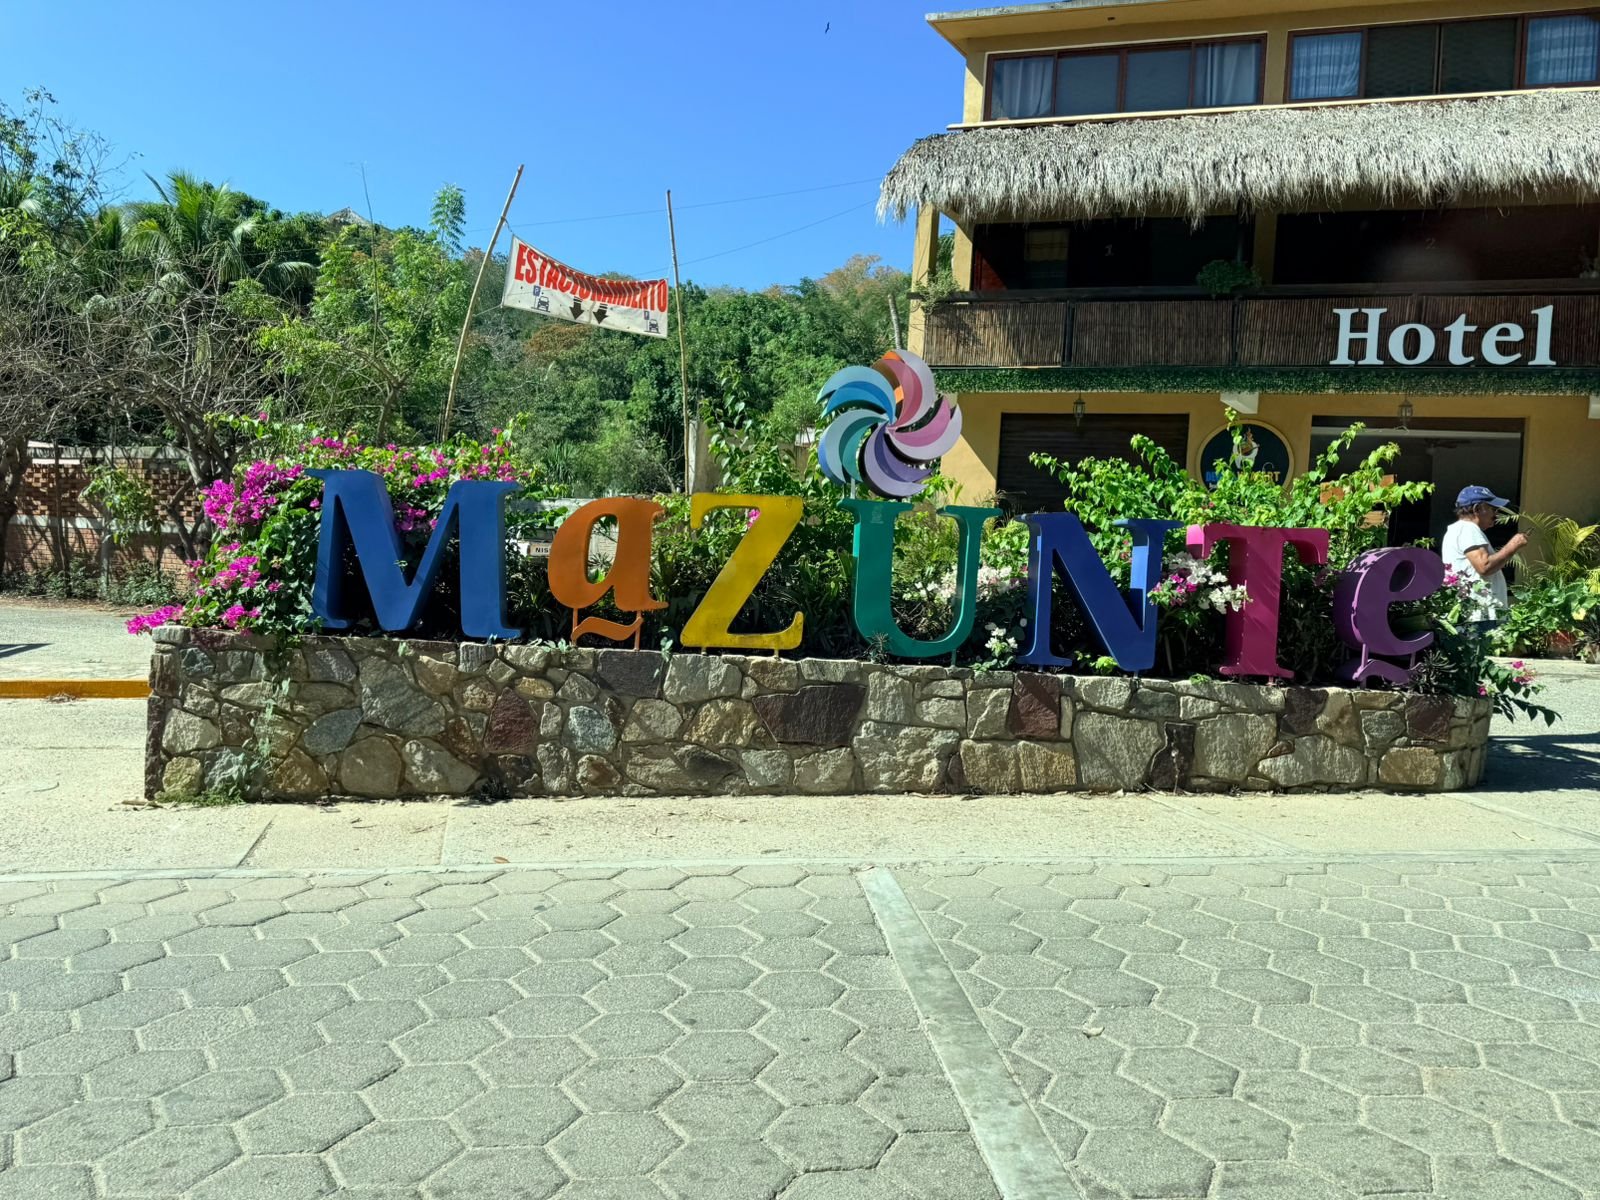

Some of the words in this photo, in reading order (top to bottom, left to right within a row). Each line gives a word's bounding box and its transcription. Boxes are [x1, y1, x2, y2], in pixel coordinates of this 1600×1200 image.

[1104, 243, 1115, 257] 1
[1425, 237, 1436, 249] 2
[514, 243, 667, 313] ESTACIONAMIENTO
[1329, 304, 1557, 366] Hotel
